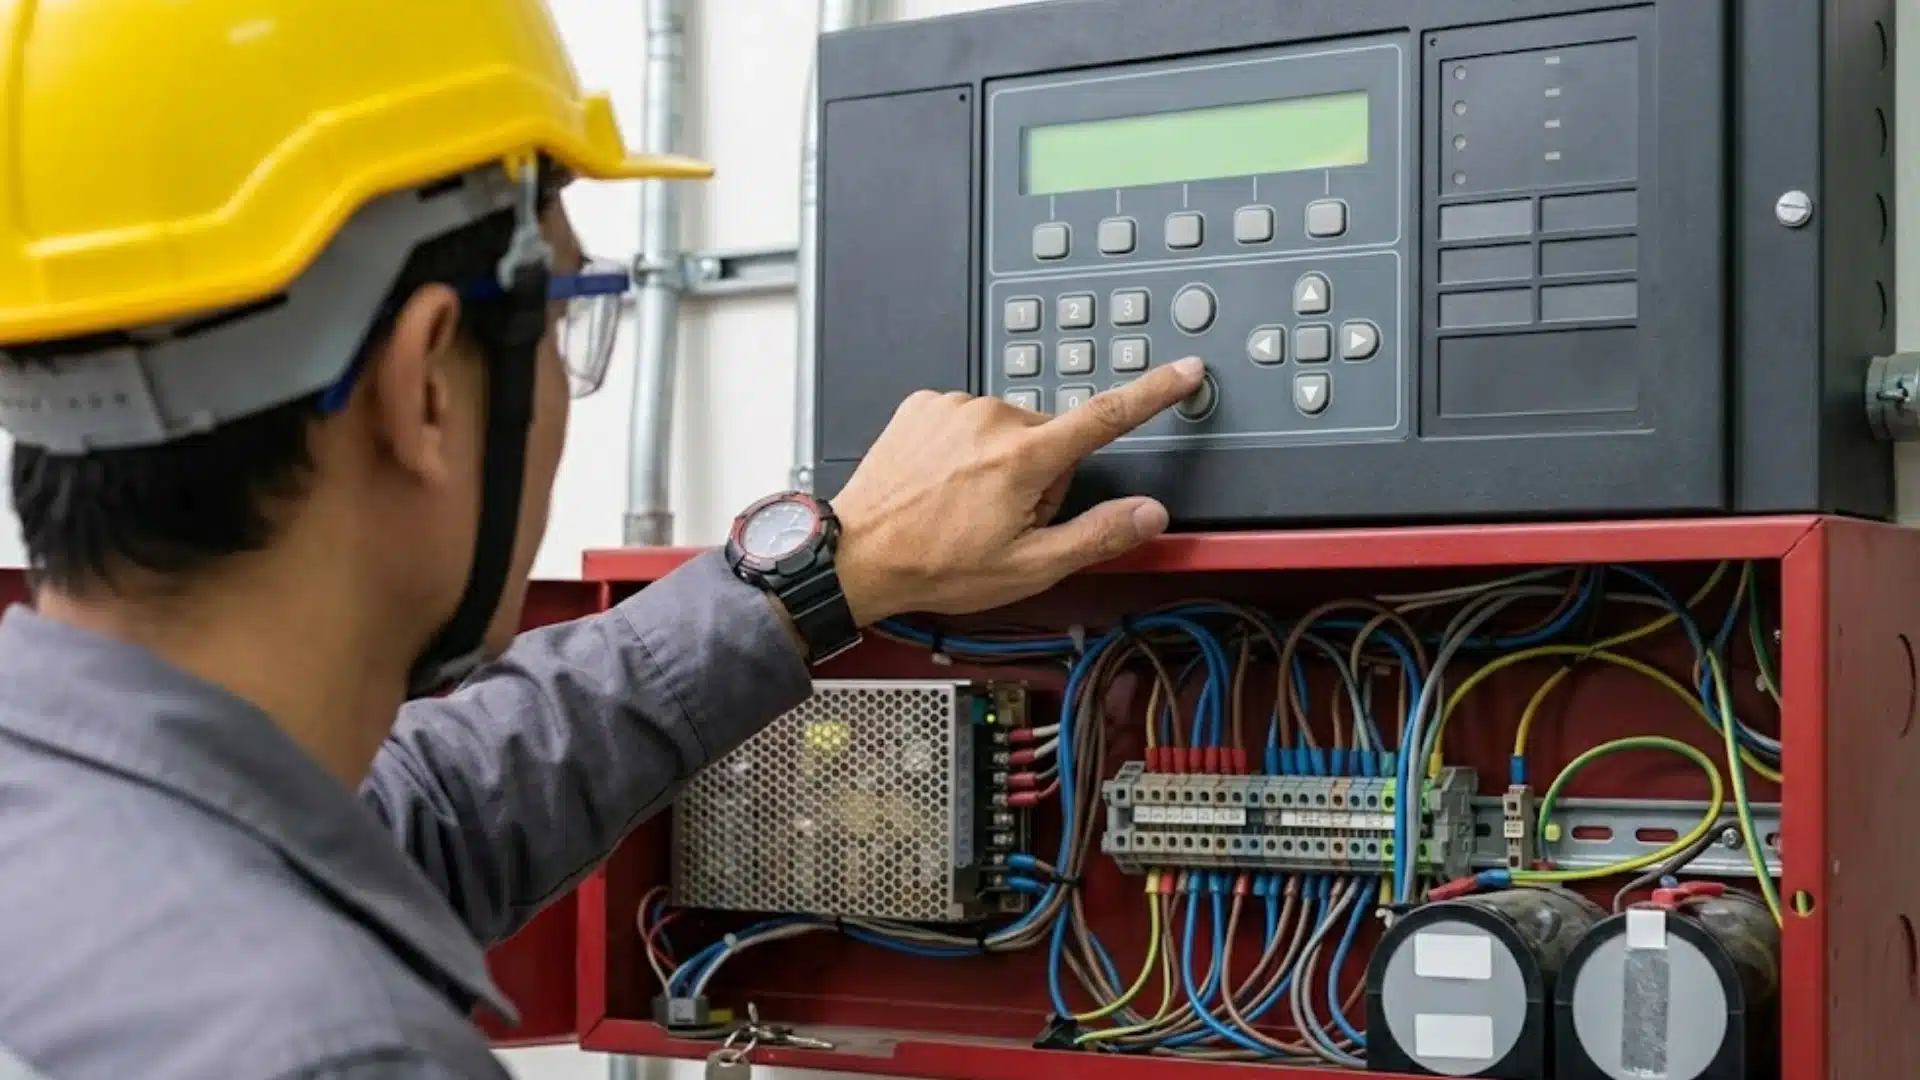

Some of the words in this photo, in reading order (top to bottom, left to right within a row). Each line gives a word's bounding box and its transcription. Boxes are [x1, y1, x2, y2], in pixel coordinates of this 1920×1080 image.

[1017, 306, 1026, 322] 1
[1069, 303, 1080, 319] 2
[1123, 299, 1133, 316] 3
[1016, 351, 1026, 367] 4
[1068, 348, 1079, 365] 5
[1123, 347, 1133, 363] 6
